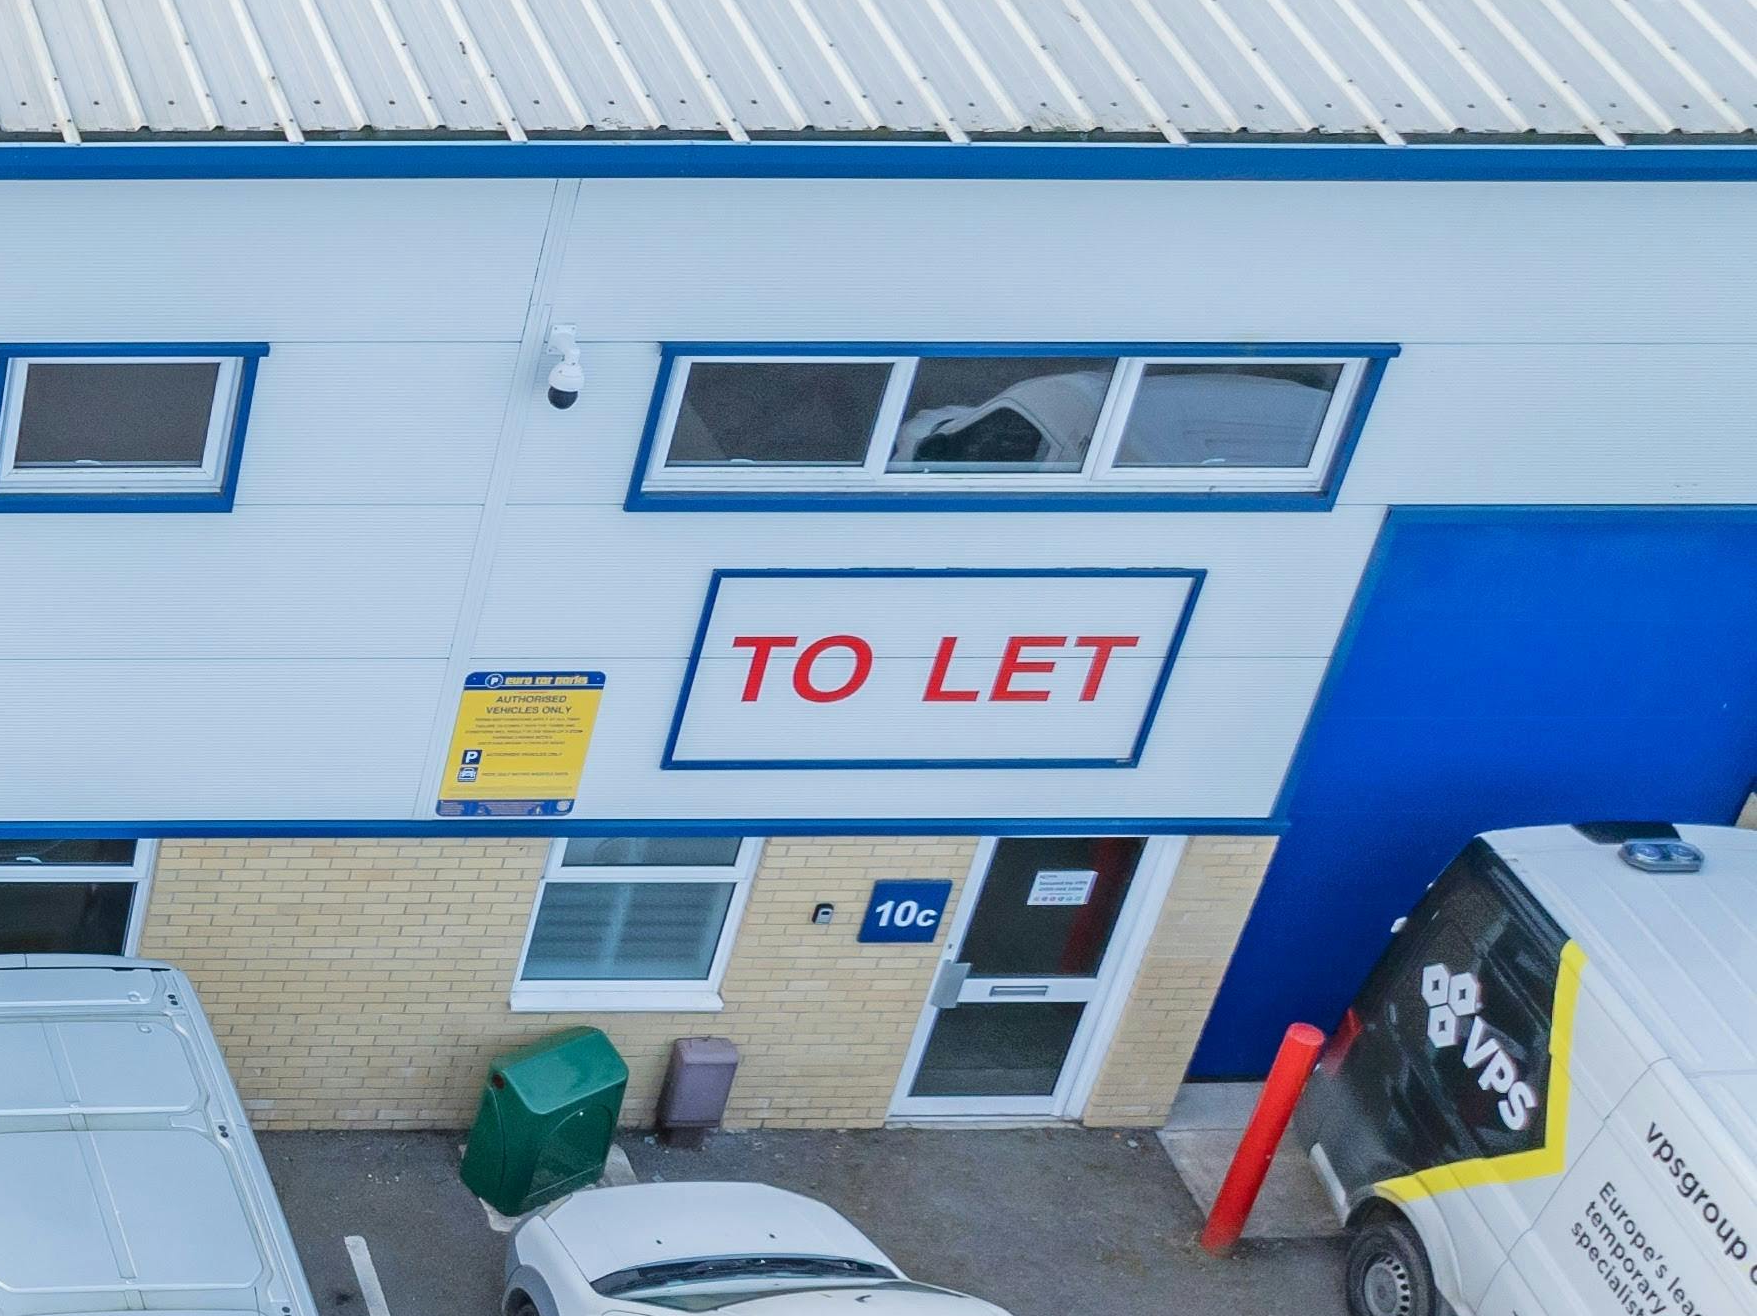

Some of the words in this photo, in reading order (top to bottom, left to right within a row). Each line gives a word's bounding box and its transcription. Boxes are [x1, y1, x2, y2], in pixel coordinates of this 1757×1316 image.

[732, 634, 873, 703] TO
[922, 635, 1140, 702] LET
[486, 706, 539, 715] VEHICLES
[541, 706, 573, 714] ONLY
[496, 695, 568, 703] AUTHORISED
[464, 751, 478, 764] P
[875, 900, 938, 927] 10c
[1462, 1014, 1538, 1131] VPS
[1598, 1181, 1668, 1279] Europe's
[1585, 1200, 1667, 1316] temporary
